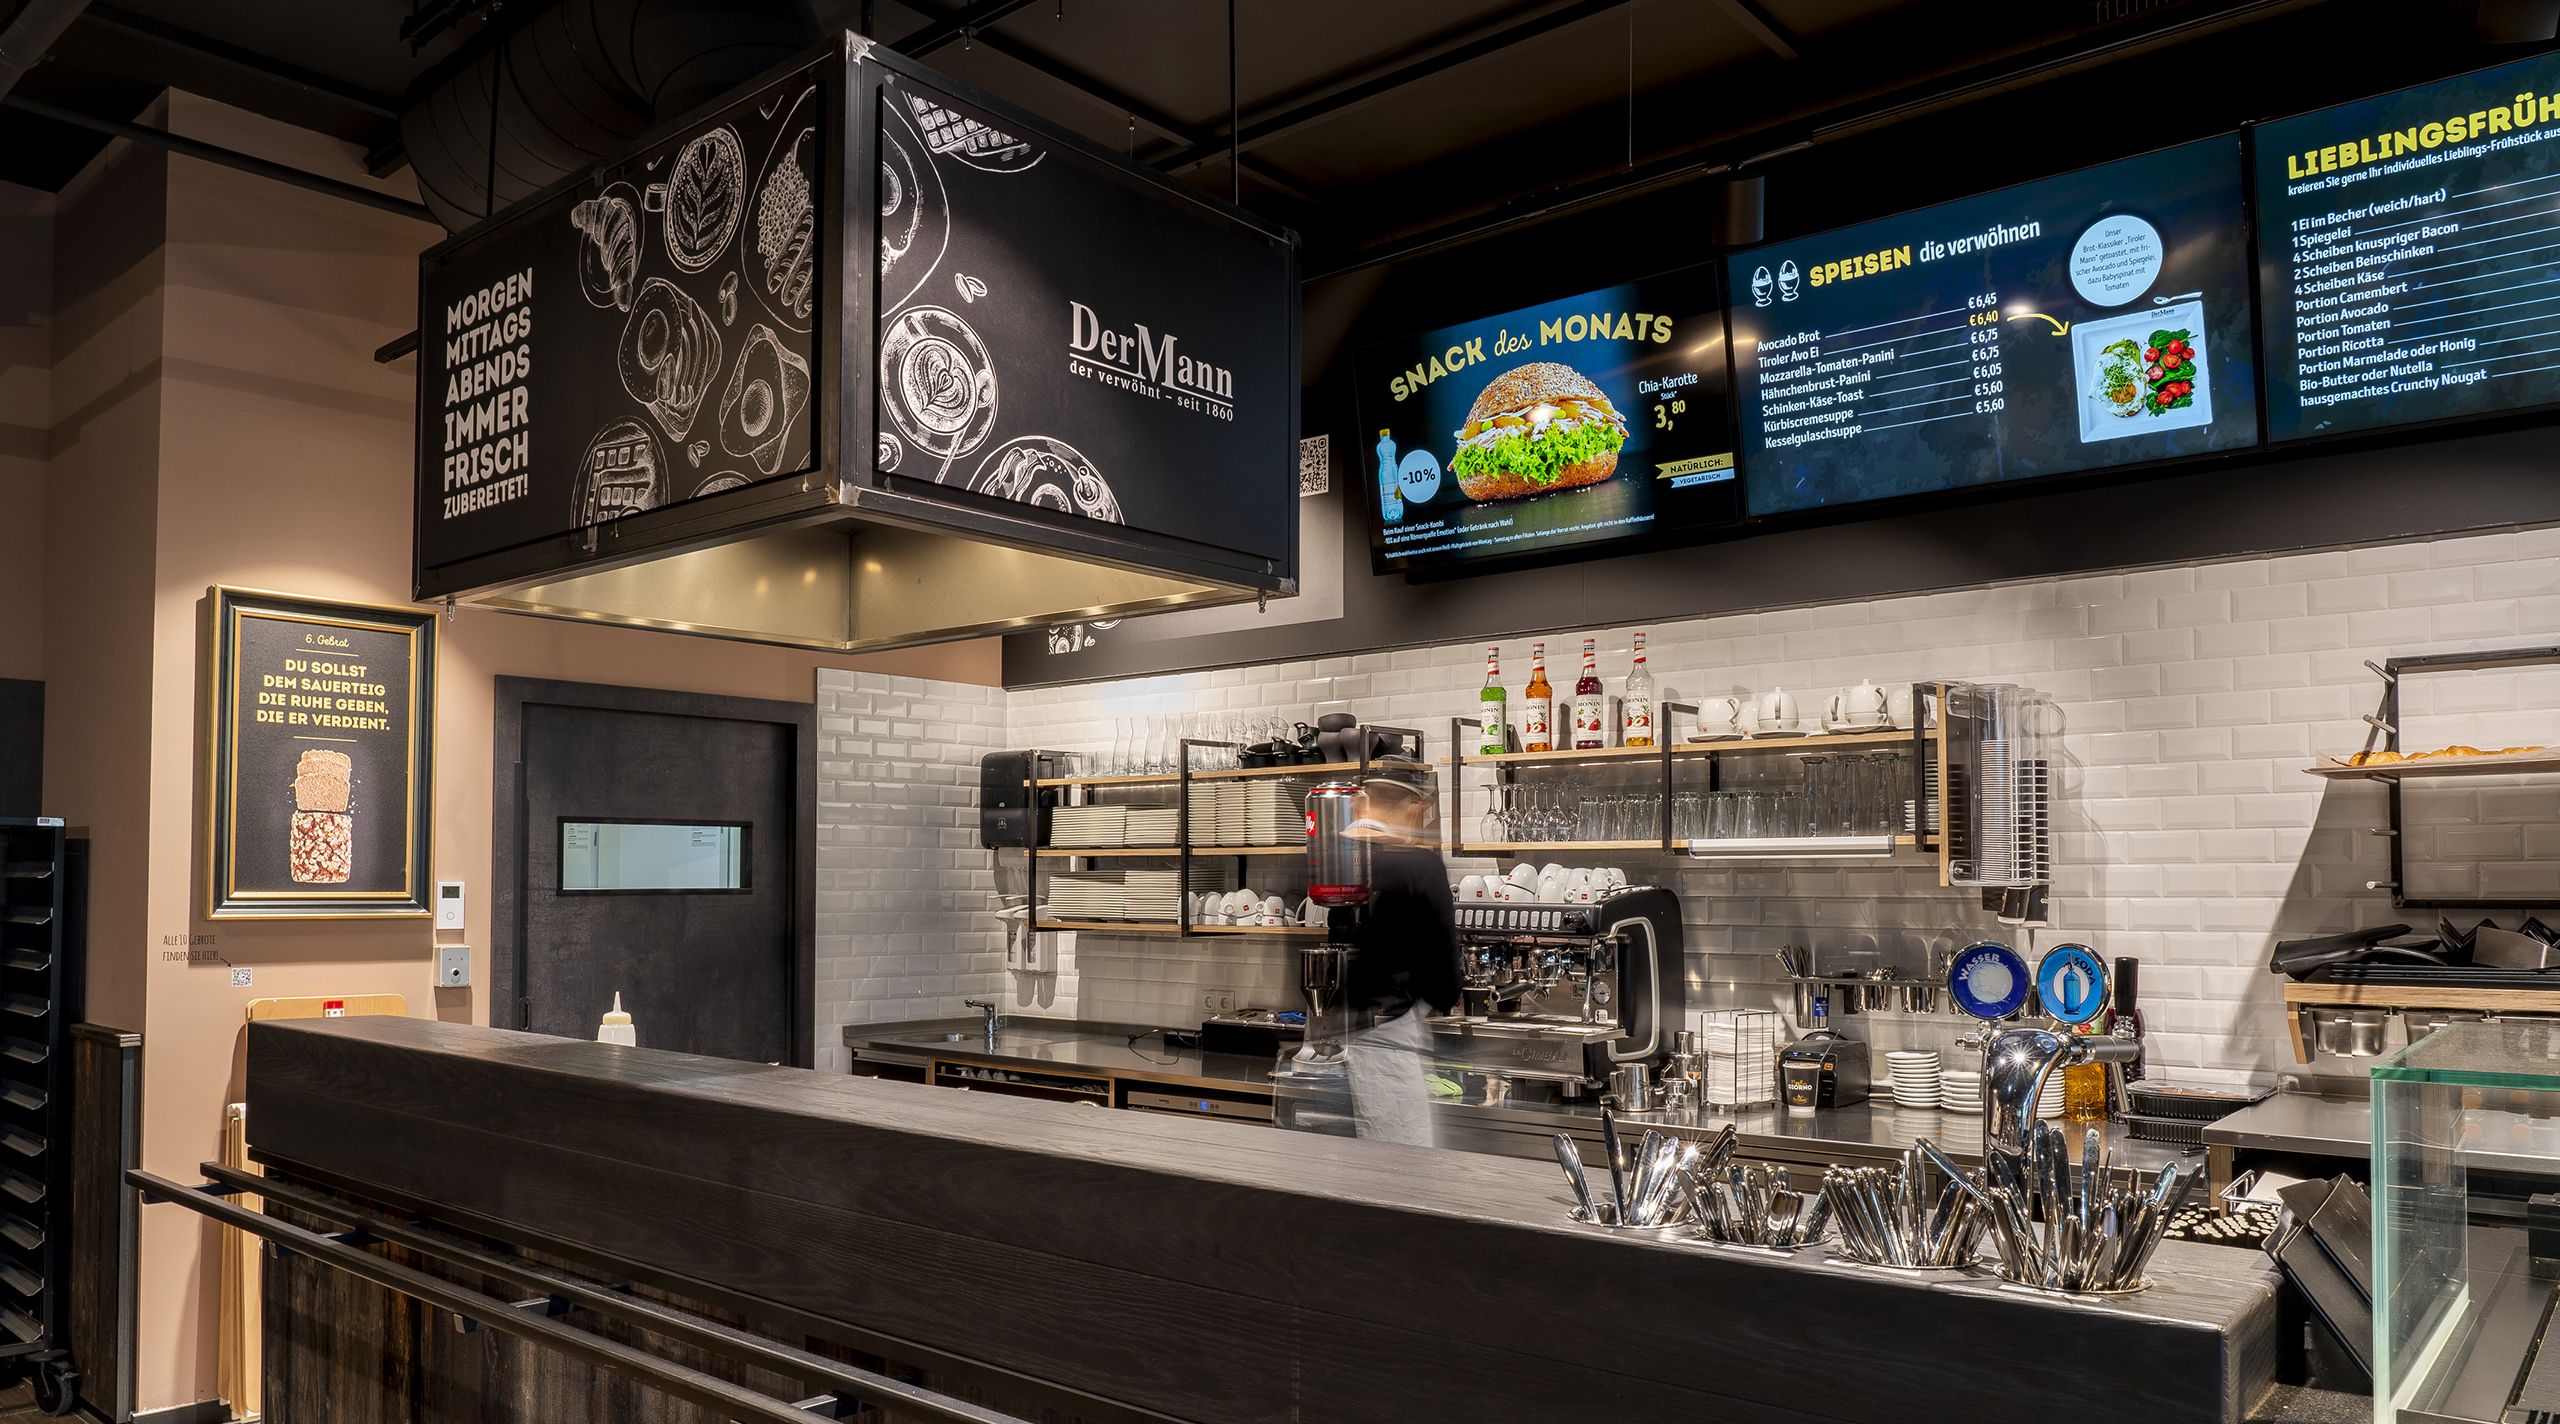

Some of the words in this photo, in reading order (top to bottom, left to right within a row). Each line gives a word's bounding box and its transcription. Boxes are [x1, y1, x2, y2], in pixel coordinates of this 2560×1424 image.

[2288, 92, 2560, 180] LIEBLINGSFRÜH
[2288, 180, 2325, 196] kreieren
[2326, 177, 2340, 187] Sie
[2341, 171, 2368, 187] gerne
[2369, 168, 2383, 178] Ihr
[2384, 154, 2443, 176] individuelles
[2444, 130, 2542, 161] Lieblings-Frühstück
[2292, 221, 2298, 232] 1
[2300, 218, 2310, 230] Ei
[2312, 217, 2326, 228] im
[2328, 208, 2367, 225] Becher
[2369, 188, 2447, 217] (weich/hart)
[2083, 239, 2124, 254] Brot-Klassiker
[2105, 228, 2122, 238] Unser
[2292, 237, 2298, 248] 1
[2300, 226, 2351, 248] Spiegelei
[2293, 253, 2301, 264] 4
[2302, 244, 2353, 262] Scheiben
[2355, 231, 2421, 252] knuspriger
[2422, 223, 2459, 239] Bacon
[1809, 245, 1912, 287] SPEISEN
[1919, 241, 1945, 263] die
[1947, 222, 2041, 257] verwöhnen
[2130, 246, 2140, 255] mit
[2295, 269, 2302, 280] 2
[2303, 261, 2354, 279] Scheiben
[2356, 245, 2434, 269] Beinschinken
[2076, 268, 2091, 277] scher
[2092, 263, 2116, 274] Avocado
[2117, 260, 2129, 269] und
[2088, 277, 2102, 285] dazu
[2103, 270, 2135, 282] Babyspinat
[2136, 267, 2146, 275] mit
[2105, 281, 2130, 292] Tomaten
[2295, 285, 2302, 296] 4
[2304, 276, 2355, 295] Scheiben
[2357, 272, 2385, 286] Käse
[2296, 297, 2338, 312] Portion
[2339, 282, 2408, 304] Camembert
[447, 267, 533, 335] MORGEN
[2297, 313, 2339, 328] Portion
[2341, 303, 2389, 320] Avocado
[446, 306, 531, 370] MITTAGS
[1758, 335, 1797, 353] Avocado
[1799, 330, 1820, 344] Brot
[1976, 293, 1997, 309] 6,45
[2298, 328, 2339, 343] Portion
[2341, 320, 2391, 336] Tomaten
[1070, 301, 1233, 399] DerMann
[1758, 354, 1790, 368] Tiroler
[1791, 350, 1809, 363] Avo
[1810, 347, 1819, 358] Ei
[1978, 310, 1999, 326] 6,40
[2298, 344, 2340, 359] Portion
[2342, 337, 2384, 352] Ricotta
[1390, 337, 1486, 402] SNACK
[1494, 329, 1533, 357] des
[1539, 312, 1673, 346] MONATS
[1760, 348, 1895, 384] Mozzarella-Tomaten-Panini
[1979, 328, 1998, 344] 6,75
[2299, 360, 2341, 376] Portion
[2343, 349, 2409, 368] Marmelade
[2411, 345, 2438, 358] oder
[2440, 338, 2476, 353] Honig
[445, 344, 530, 407] ABENDS
[1639, 373, 1698, 394] Chia-Karotte
[1761, 370, 1871, 401] Hähnchenbrust-Panini
[1980, 346, 1999, 361] 6,75
[2300, 373, 2360, 391] Bio-Butter
[2362, 369, 2389, 382] oder
[2390, 361, 2433, 378] Nutella
[2301, 384, 2390, 407] hausgemachtes
[2391, 377, 2440, 393] Crunchy
[2442, 369, 2488, 386] Nougat
[1070, 360, 1093, 379] der
[1098, 370, 1161, 400] verwöhnt
[1178, 396, 1200, 412] seit
[1206, 403, 1234, 422] 1860
[1763, 389, 1864, 417] Schinken-Käse-Toast
[1981, 363, 2002, 379] 6,05
[445, 385, 529, 452] IMMER
[1764, 409, 1854, 433] Kürbiscremesuppe
[1983, 381, 2003, 396] 5,60
[1765, 425, 1862, 449] Kesselgulaschsuppe
[1984, 398, 2005, 414] 5,60
[444, 430, 529, 493] FRISCH
[1403, 468, 1436, 484] -10%
[1671, 459, 1724, 474] NATÜRLICH:
[1679, 473, 1721, 485] VEGETARISCH
[444, 473, 528, 520] ZUBEREITET!
[305, 634, 316, 645] 6.
[285, 659, 308, 673] DU
[311, 662, 367, 678] SOLLST
[264, 675, 296, 690] DEM
[301, 678, 386, 697] SAUERTEIG
[259, 692, 286, 706] DIE
[291, 695, 332, 710] RUHE
[336, 698, 389, 715] GEBEN,
[257, 709, 284, 724] DIE
[288, 711, 309, 726] ER
[312, 713, 391, 732] VERDIENT.
[179, 934, 188, 946] 10
[1959, 953, 2001, 981] WASSER
[2073, 957, 2097, 986] SODA
